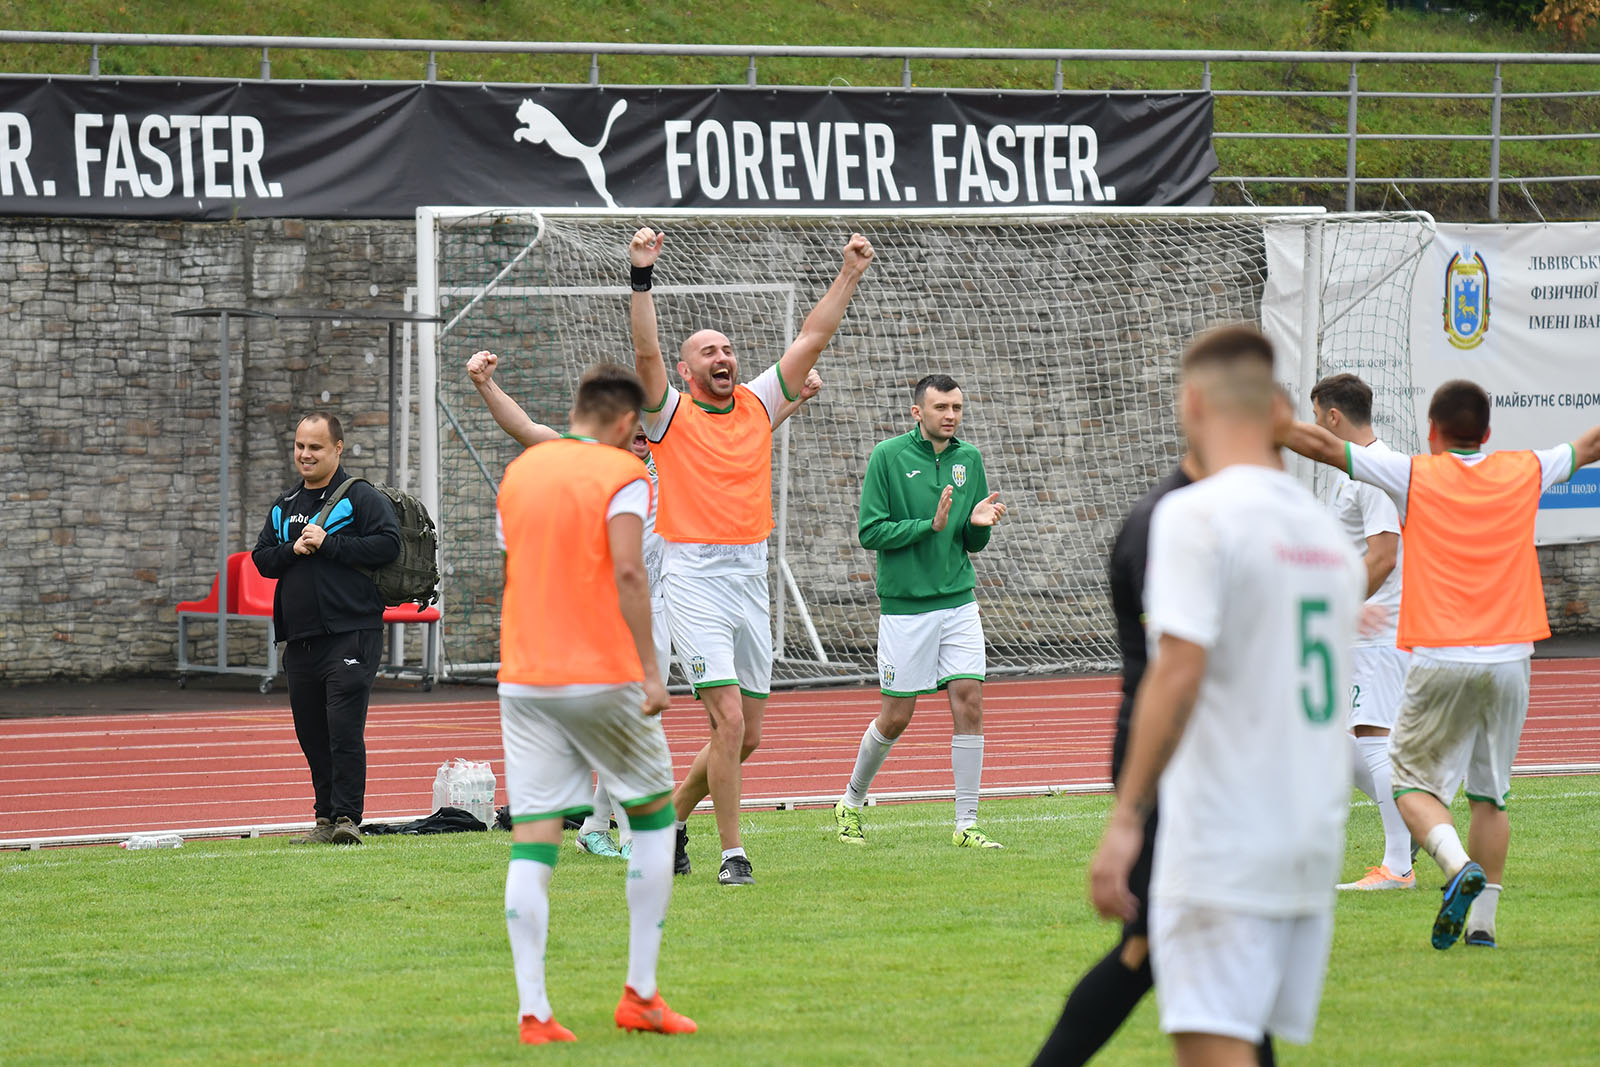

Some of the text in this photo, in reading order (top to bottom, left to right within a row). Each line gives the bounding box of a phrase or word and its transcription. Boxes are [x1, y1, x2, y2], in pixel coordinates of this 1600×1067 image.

[74, 112, 284, 198] FASTER.
[665, 119, 1117, 203] FOREVER. FASTER.
[1528, 255, 1600, 270] ЛЬВІВСЬК
[1530, 281, 1599, 300] ФІЗИЧНОЇ
[1529, 315, 1570, 330] ІМЕНІ
[1495, 391, 1556, 408] МАЙБУТНЄ
[1571, 483, 1597, 495] щодо
[1297, 597, 1337, 725] 5
